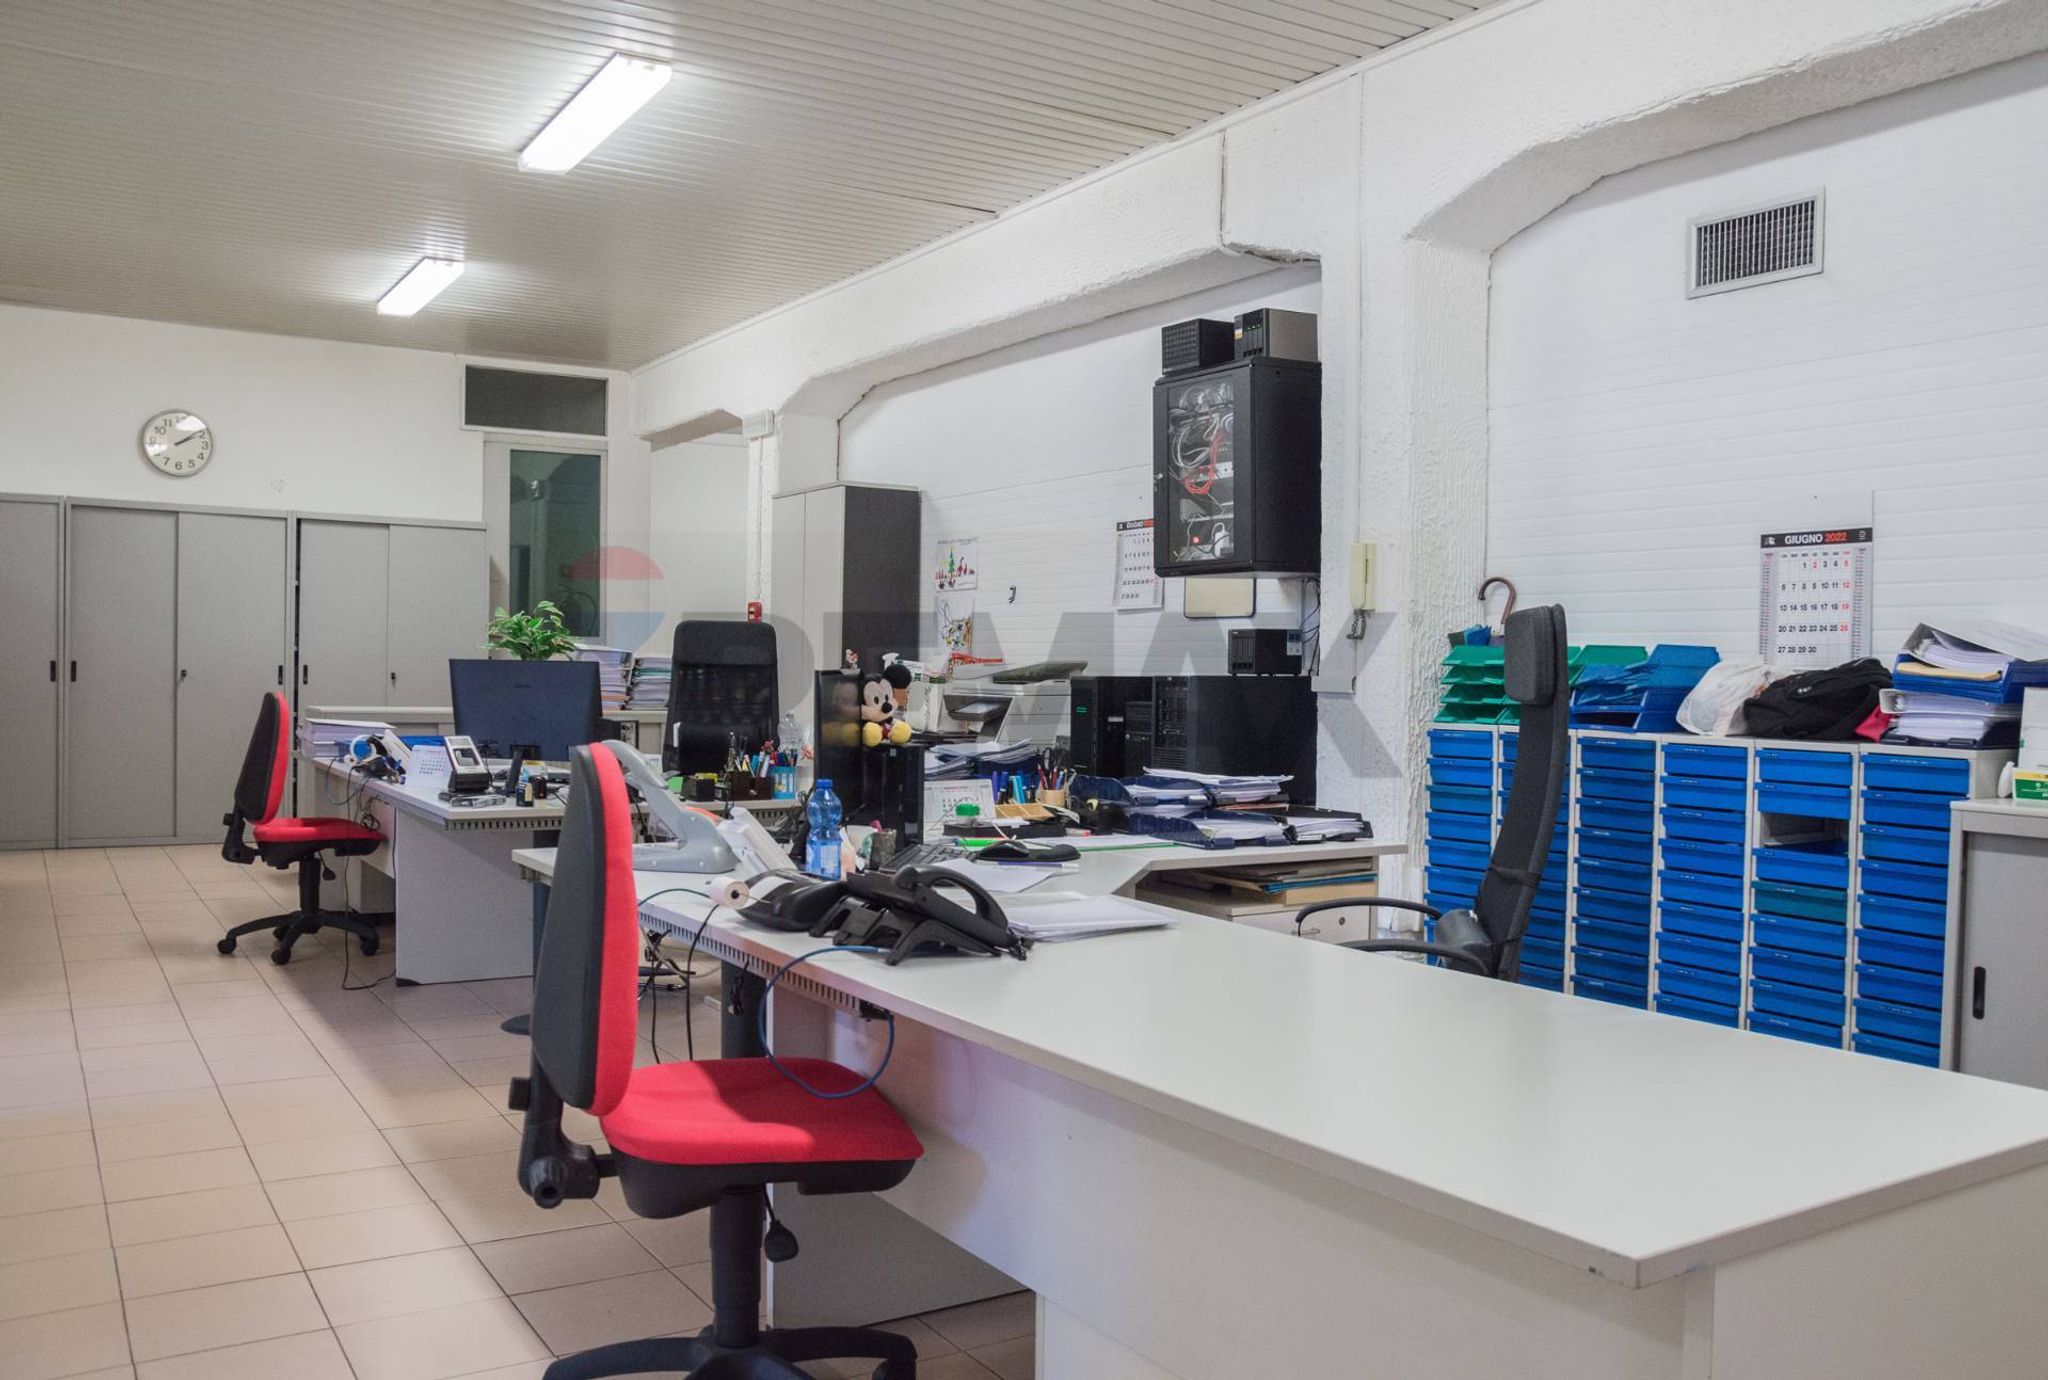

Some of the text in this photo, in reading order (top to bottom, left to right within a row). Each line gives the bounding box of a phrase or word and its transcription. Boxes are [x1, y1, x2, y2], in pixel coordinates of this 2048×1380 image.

[163, 419, 172, 427] 11
[154, 426, 167, 435] 10
[201, 441, 208, 450] 3
[163, 457, 170, 466] 7
[175, 461, 182, 470] 6
[188, 459, 195, 468] 5
[1784, 533, 1823, 545] GIUGNO
[1824, 532, 1848, 542] 2022
[1781, 583, 1786, 591] 6
[1812, 582, 1817, 590] 9
